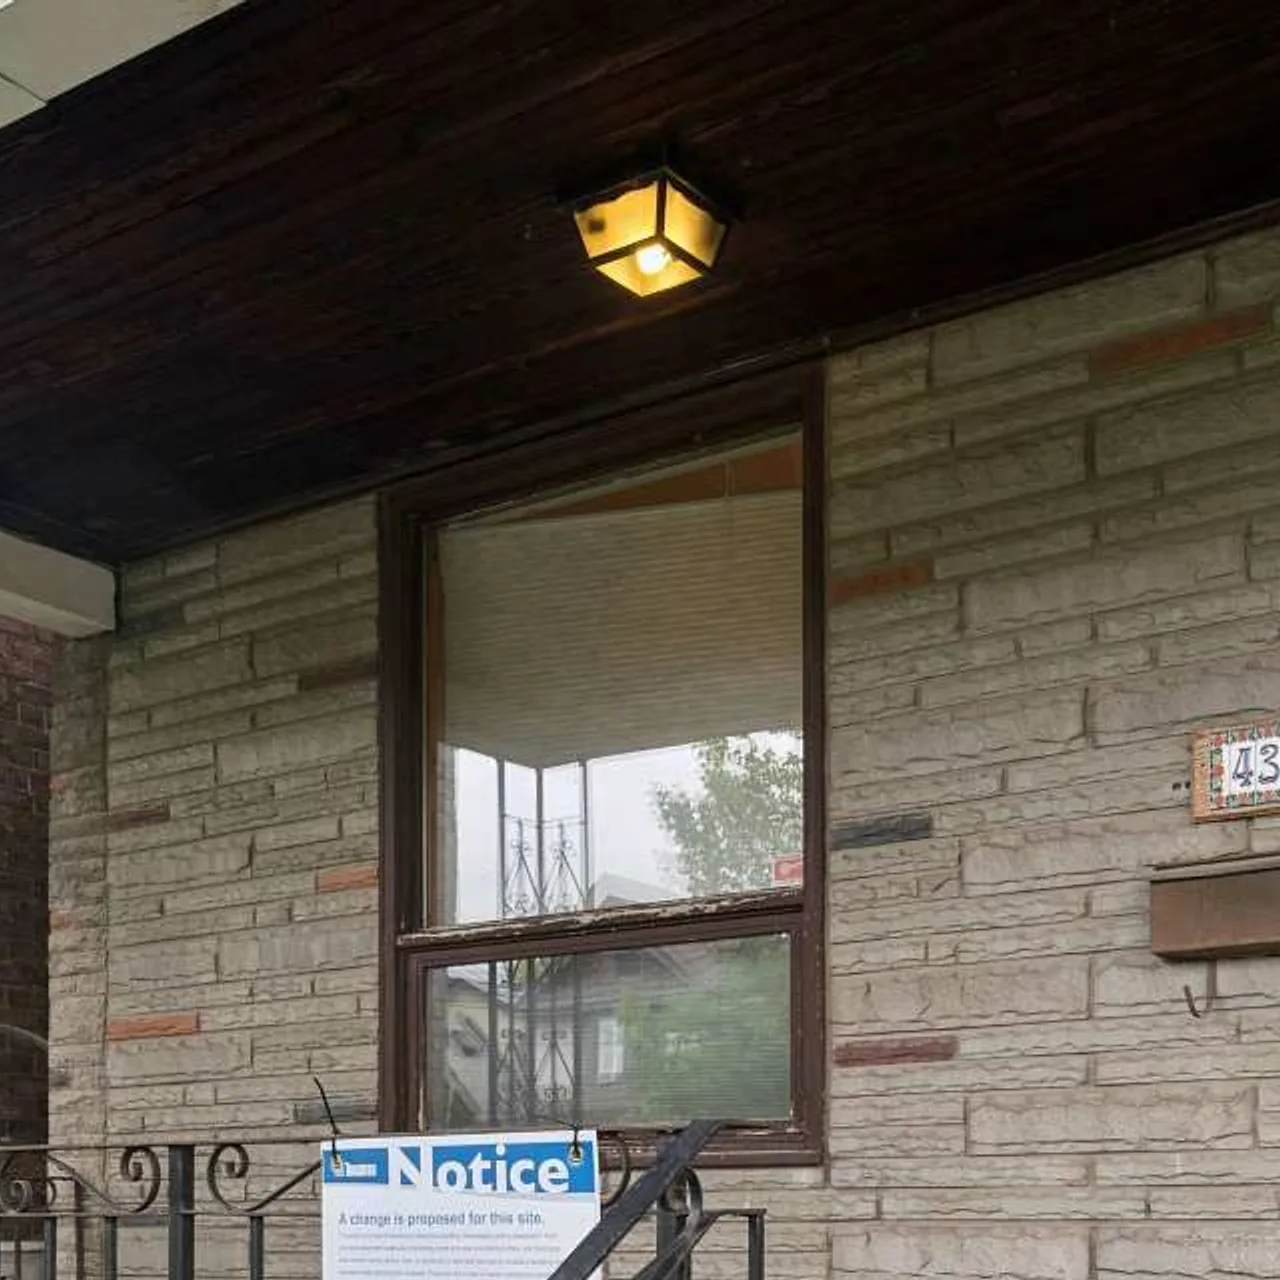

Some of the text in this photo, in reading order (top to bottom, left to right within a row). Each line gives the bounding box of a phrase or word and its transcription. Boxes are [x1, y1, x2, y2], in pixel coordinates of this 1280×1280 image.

[1232, 744, 1279, 787] 43
[388, 1143, 569, 1194] Notice
[339, 1210, 545, 1228] A change is proposed for this site.
